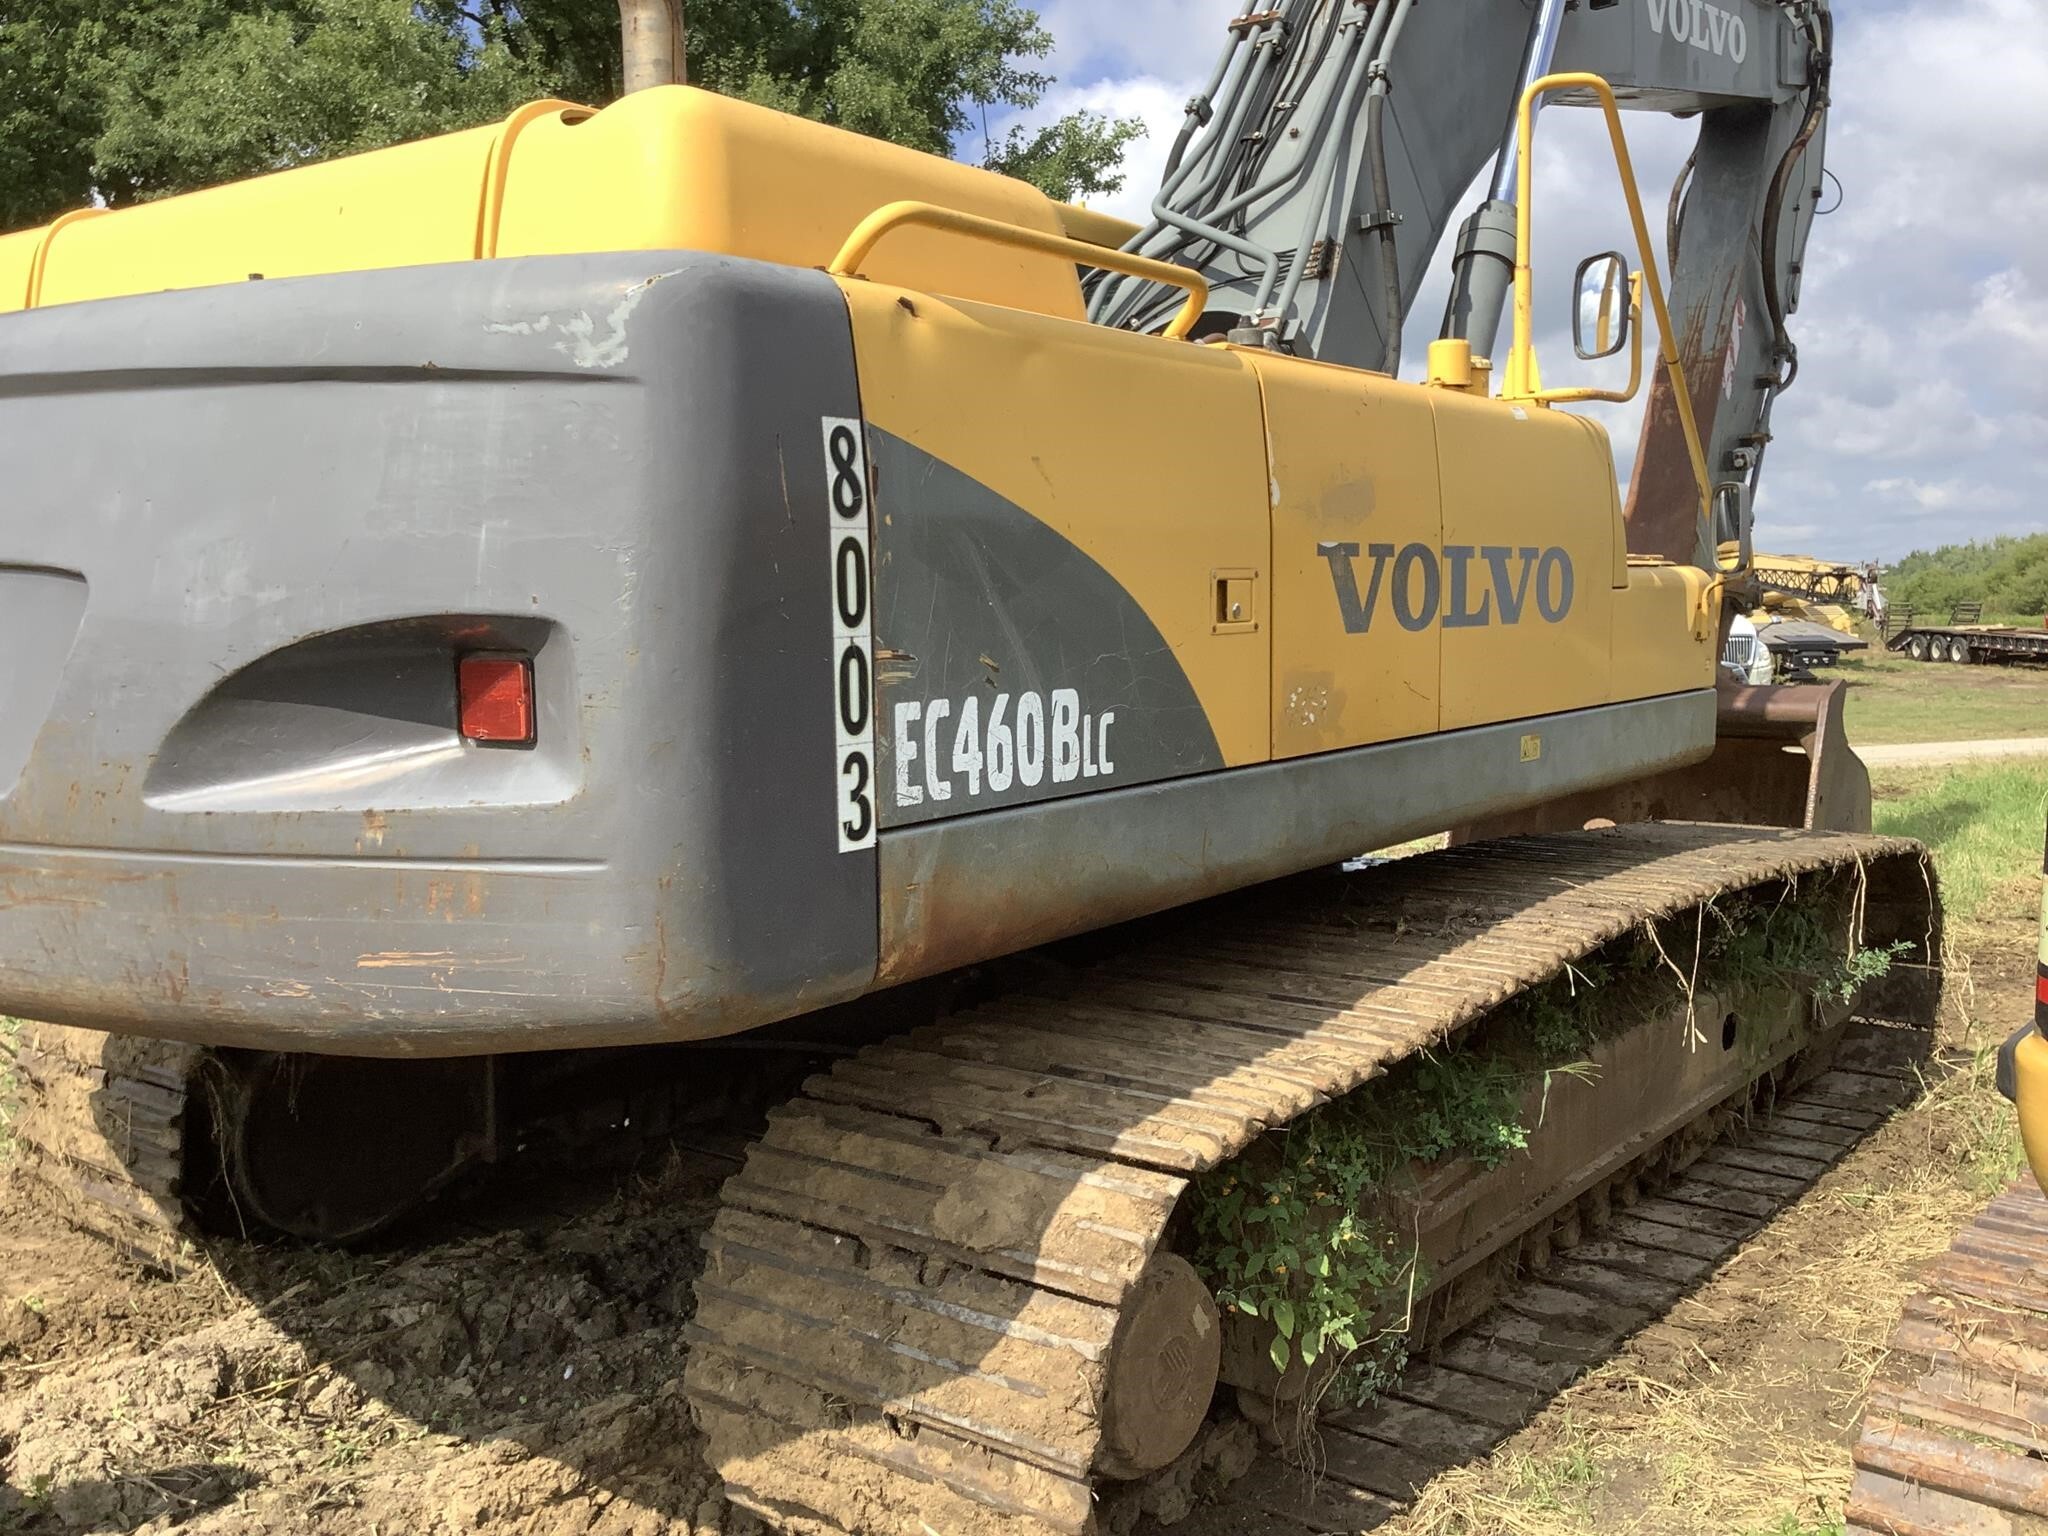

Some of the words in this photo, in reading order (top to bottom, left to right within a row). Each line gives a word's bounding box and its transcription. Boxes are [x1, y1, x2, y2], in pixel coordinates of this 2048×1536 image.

[1647, 0, 1747, 64] VOLVO
[829, 425, 872, 843] 8003
[1317, 542, 1575, 634] VOLVO
